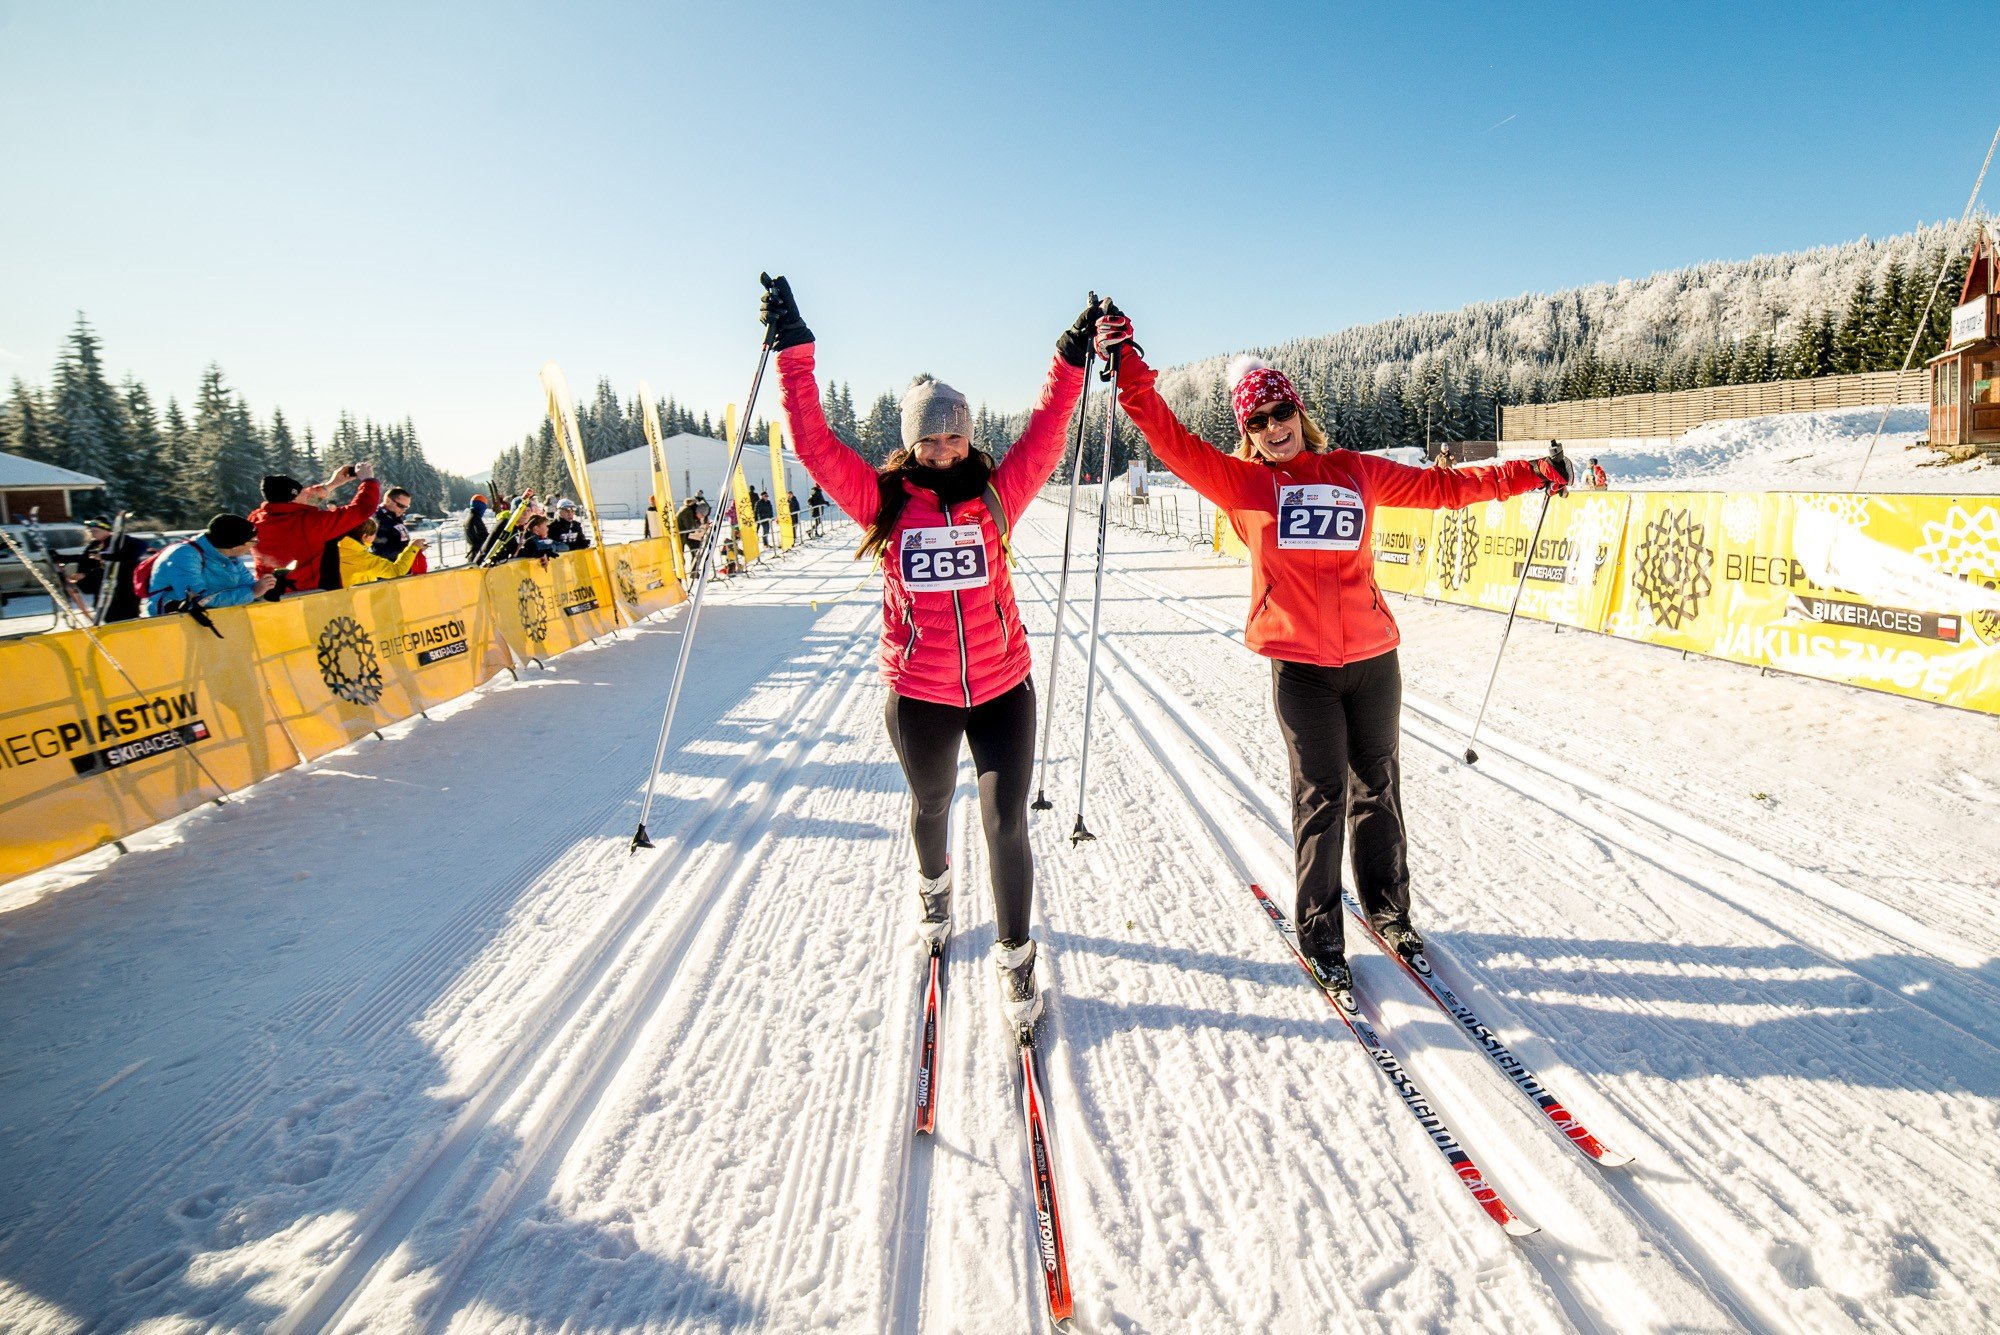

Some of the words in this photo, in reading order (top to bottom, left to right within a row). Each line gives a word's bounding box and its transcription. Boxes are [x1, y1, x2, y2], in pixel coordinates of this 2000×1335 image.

[1289, 508, 1355, 537] 276
[910, 549, 977, 579] 263
[1527, 565, 1565, 580] IKERACES
[1812, 601, 1922, 633] BIKERACES
[429, 642, 466, 661] SKIRACES
[1714, 622, 1953, 695] JAKUSZYCE
[0, 691, 198, 769] IEGPIASTÓW
[106, 731, 182, 765] SKIRACES
[1450, 1004, 1552, 1108] ROSSIGNOL
[917, 1067, 929, 1108] ATOMIC
[1370, 1048, 1464, 1165] ROSSIGNOL
[1037, 1209, 1057, 1273] ATOMIC
